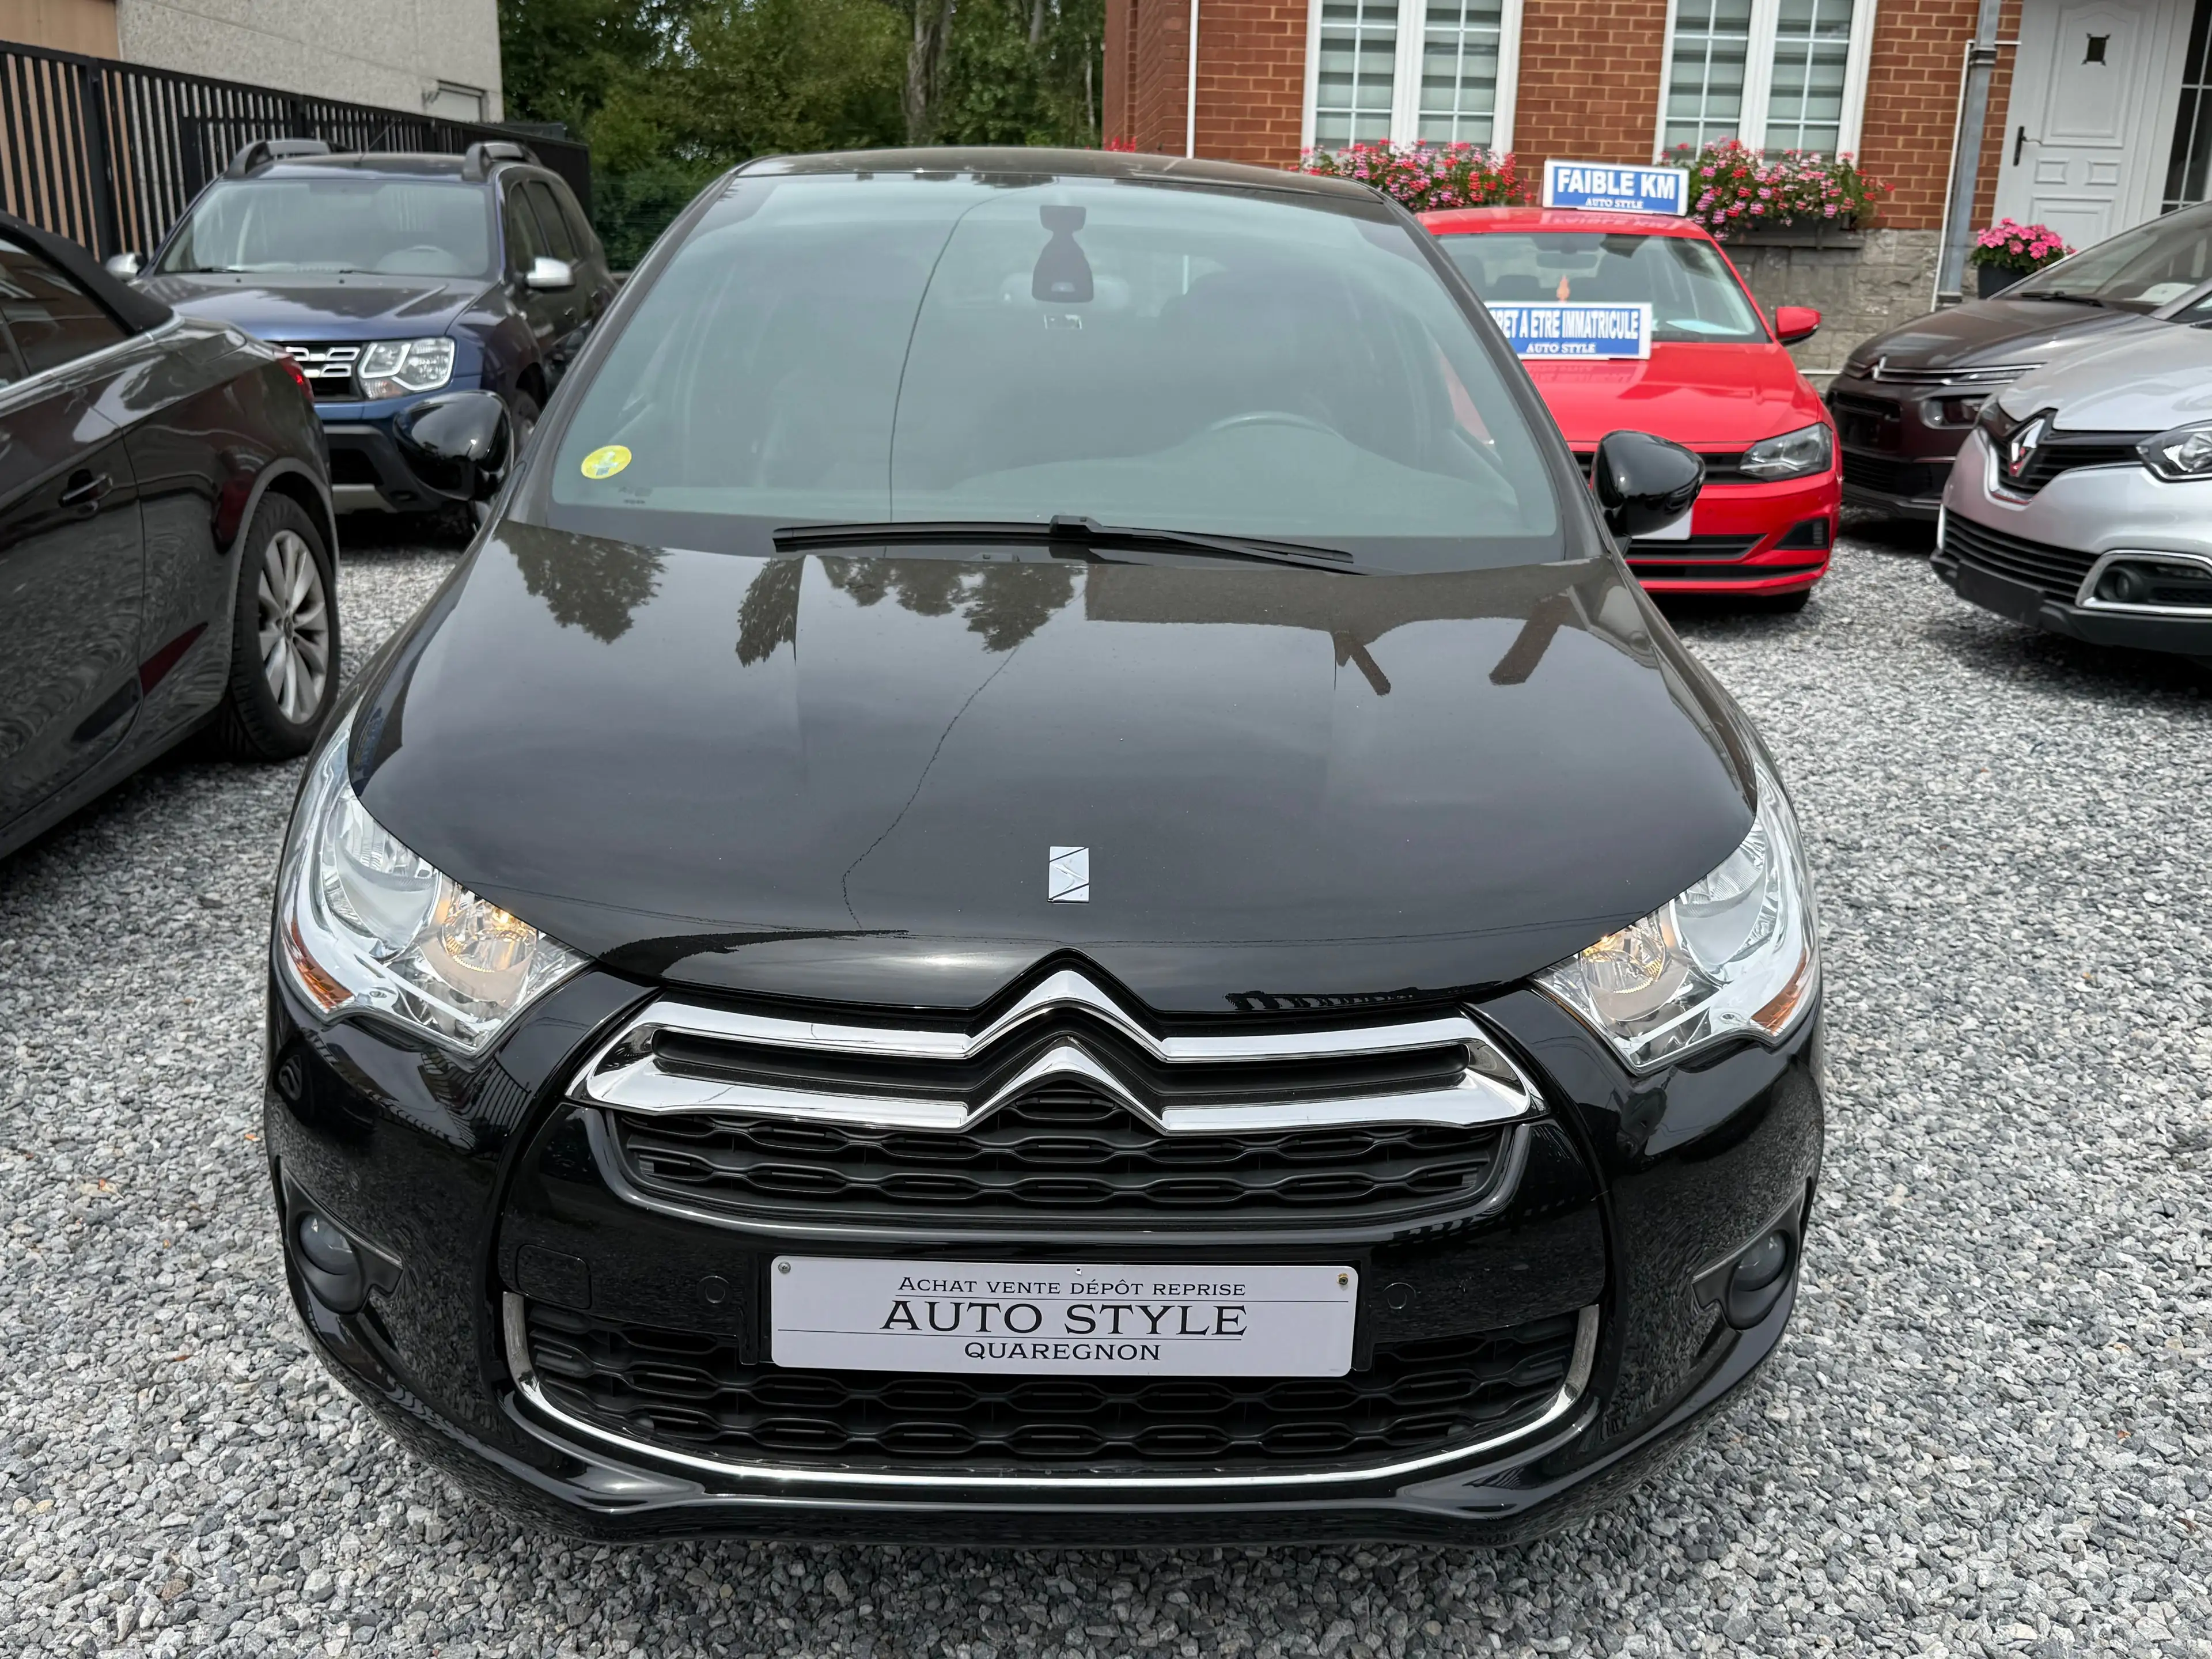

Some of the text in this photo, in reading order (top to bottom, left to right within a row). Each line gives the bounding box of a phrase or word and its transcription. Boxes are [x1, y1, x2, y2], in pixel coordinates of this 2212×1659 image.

[1558, 168, 1675, 200] FAIBLE KM
[1585, 198, 1643, 209] AUTO STYLE
[1519, 309, 1529, 339] A
[1530, 309, 1561, 339] ETRE
[1562, 310, 1639, 339] IMMATRICULE
[1526, 342, 1596, 354] AUTO STYLE
[897, 1277, 1246, 1296] ACHAT VENTE DÉPÔT REPRISE
[879, 1300, 1248, 1336] AUTO STYLE
[964, 1342, 1161, 1361] QUAREGNON
